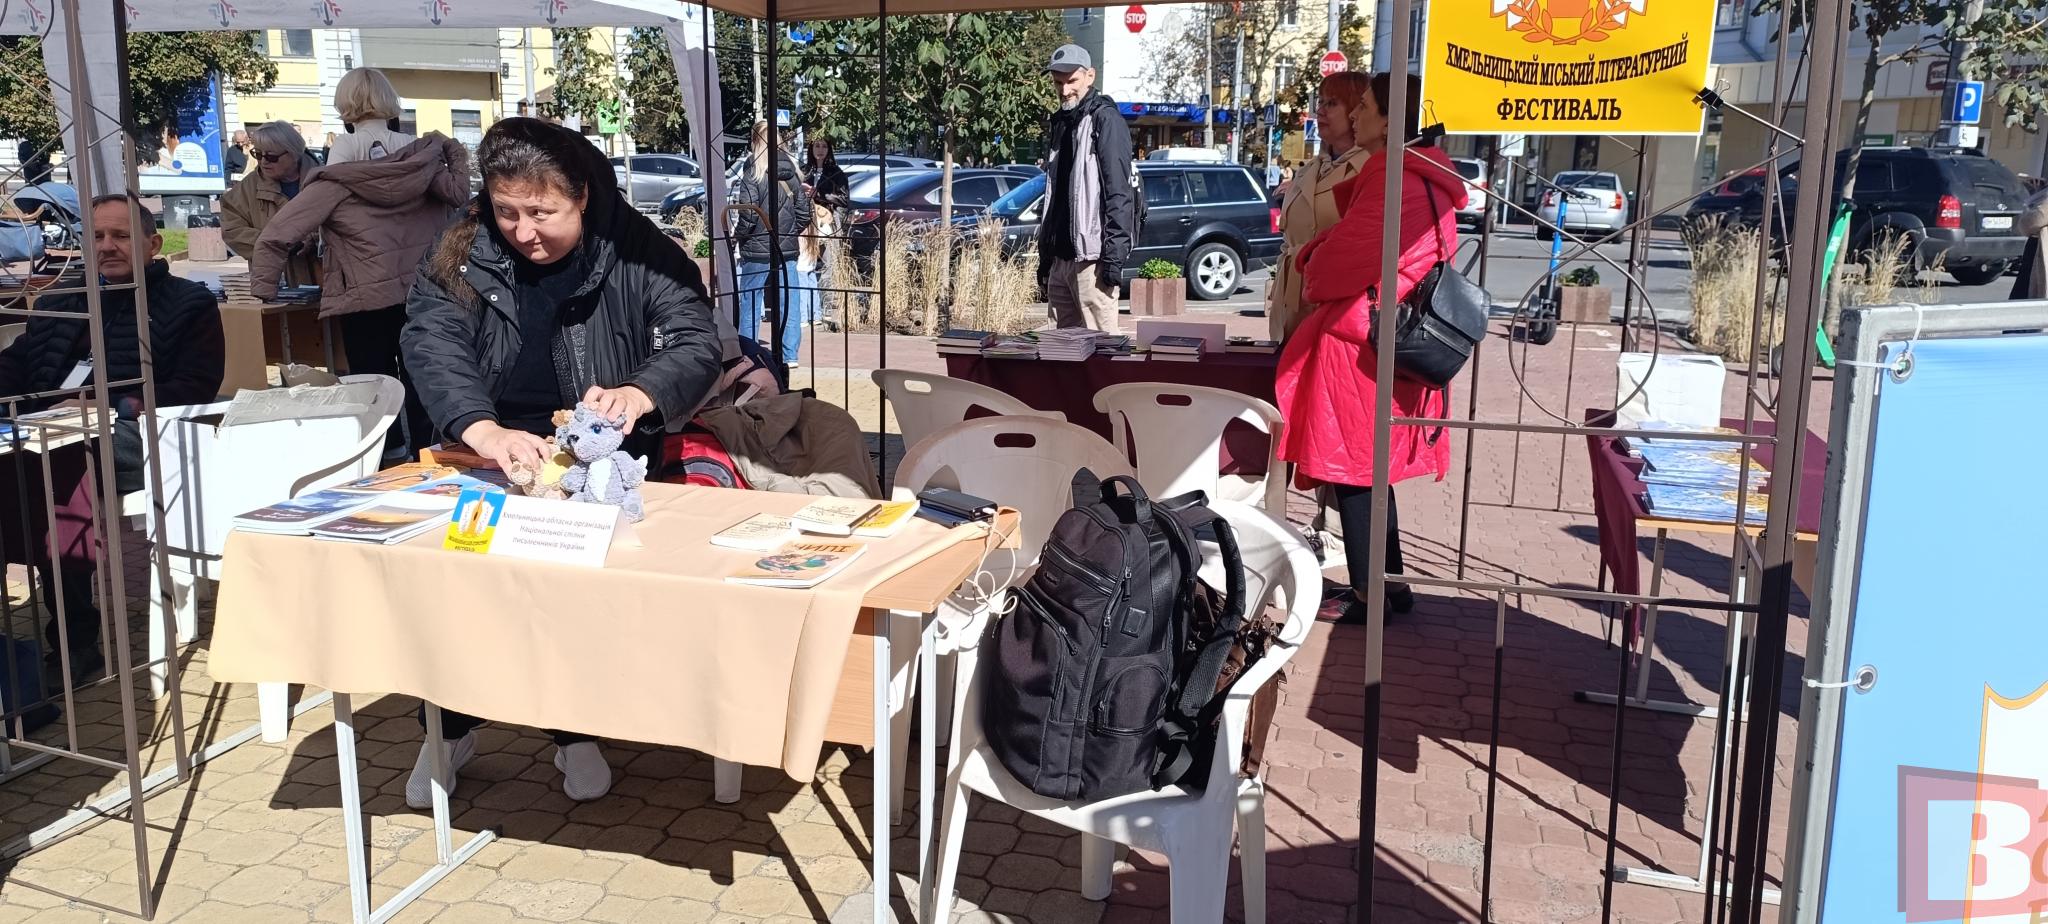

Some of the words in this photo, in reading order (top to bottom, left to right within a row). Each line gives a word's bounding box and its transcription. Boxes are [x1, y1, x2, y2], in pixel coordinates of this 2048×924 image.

[1126, 12, 1147, 24] STOP
[1321, 60, 1346, 72] STOP
[1445, 42, 1540, 88] ХМЕЛЬНИЦЬКИЙ
[1540, 54, 1595, 87] МІСЬКИЙ
[1595, 32, 1689, 85] ЛІТЕРАТУРНИЙ
[1497, 98, 1622, 121] ФЕСТИВАЛЬ
[1960, 87, 1976, 117] P
